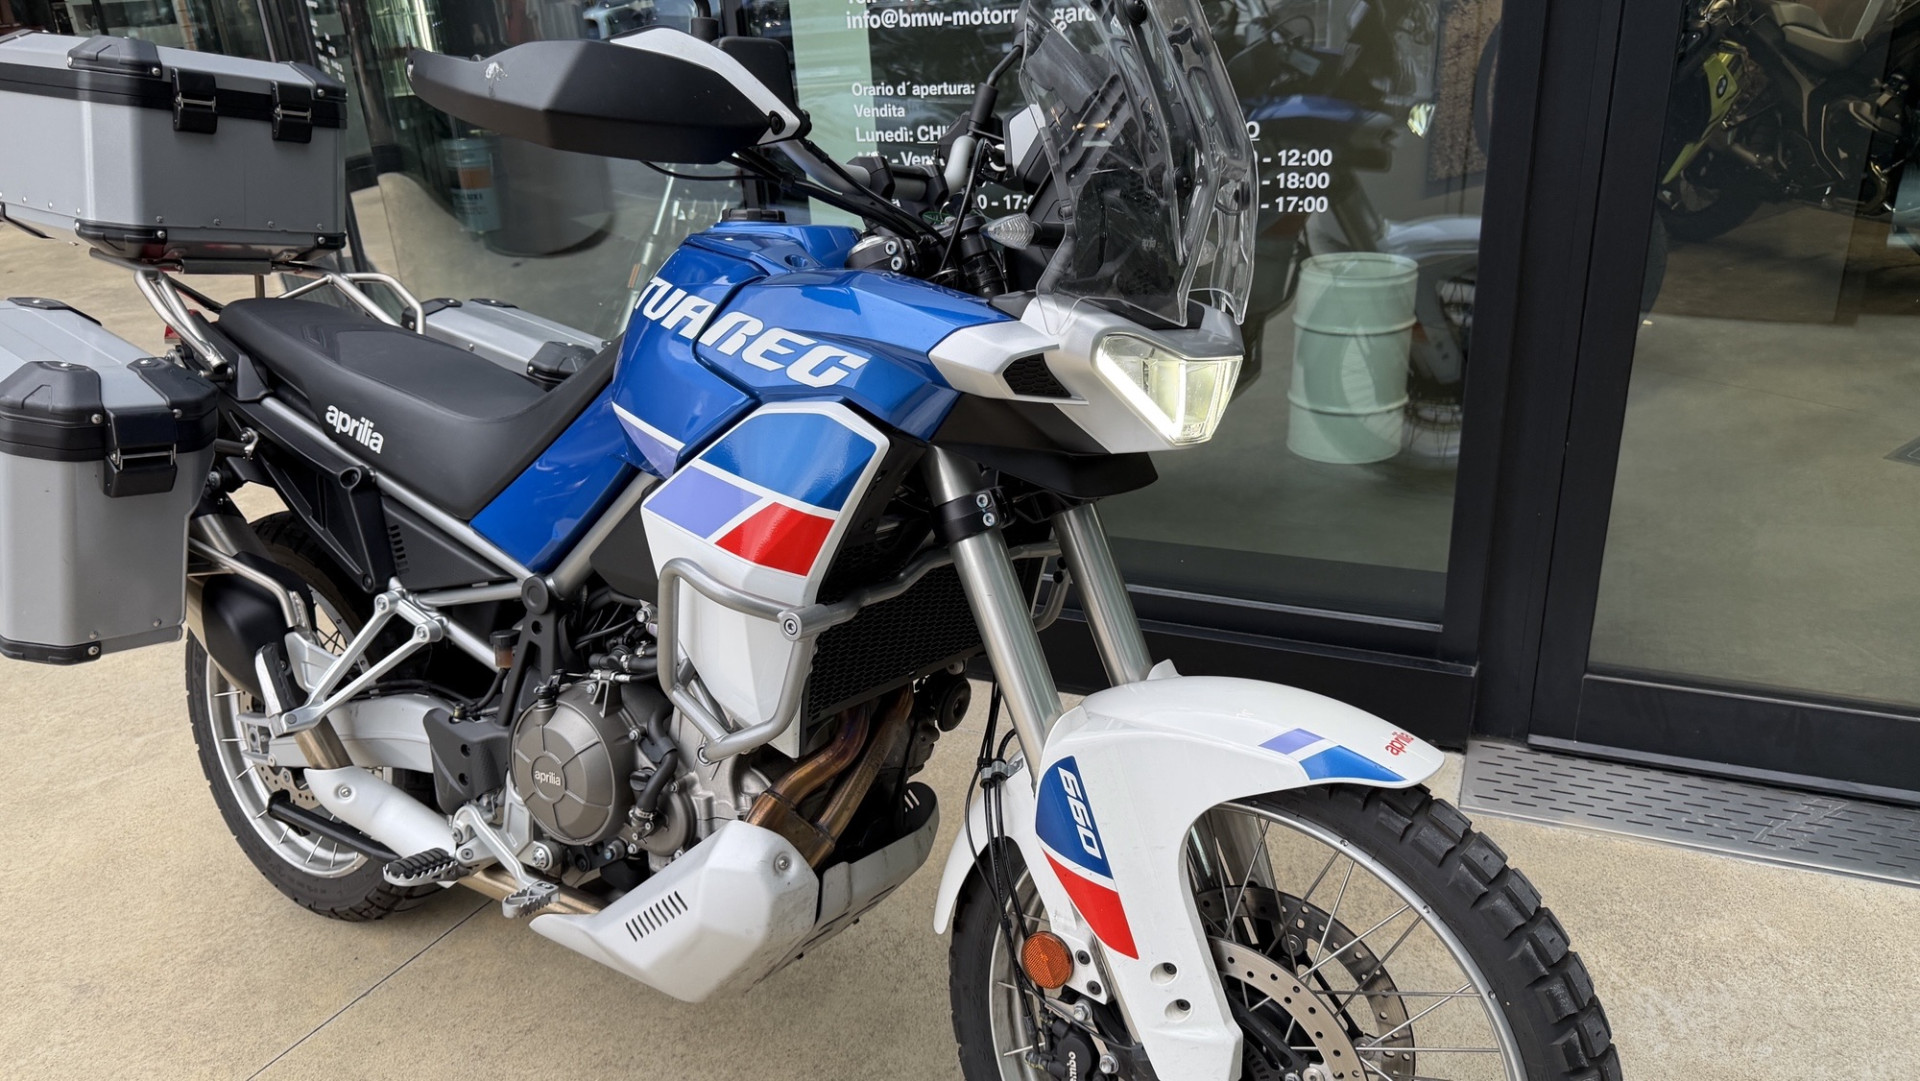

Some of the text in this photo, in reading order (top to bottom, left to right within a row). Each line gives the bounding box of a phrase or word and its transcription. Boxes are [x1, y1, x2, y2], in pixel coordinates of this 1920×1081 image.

[851, 82, 894, 97] Orario
[854, 103, 906, 118] Vendita
[855, 126, 914, 142] Lunedì:
[1277, 149, 1333, 167] 12:00
[1276, 172, 1330, 189] 18:00
[1275, 196, 1329, 213] 17:00
[634, 276, 870, 388] TUAREG
[325, 404, 384, 454] aprilia
[1385, 731, 1414, 756] aprilia
[534, 770, 561, 786] aprilia
[1057, 766, 1102, 860] 660
